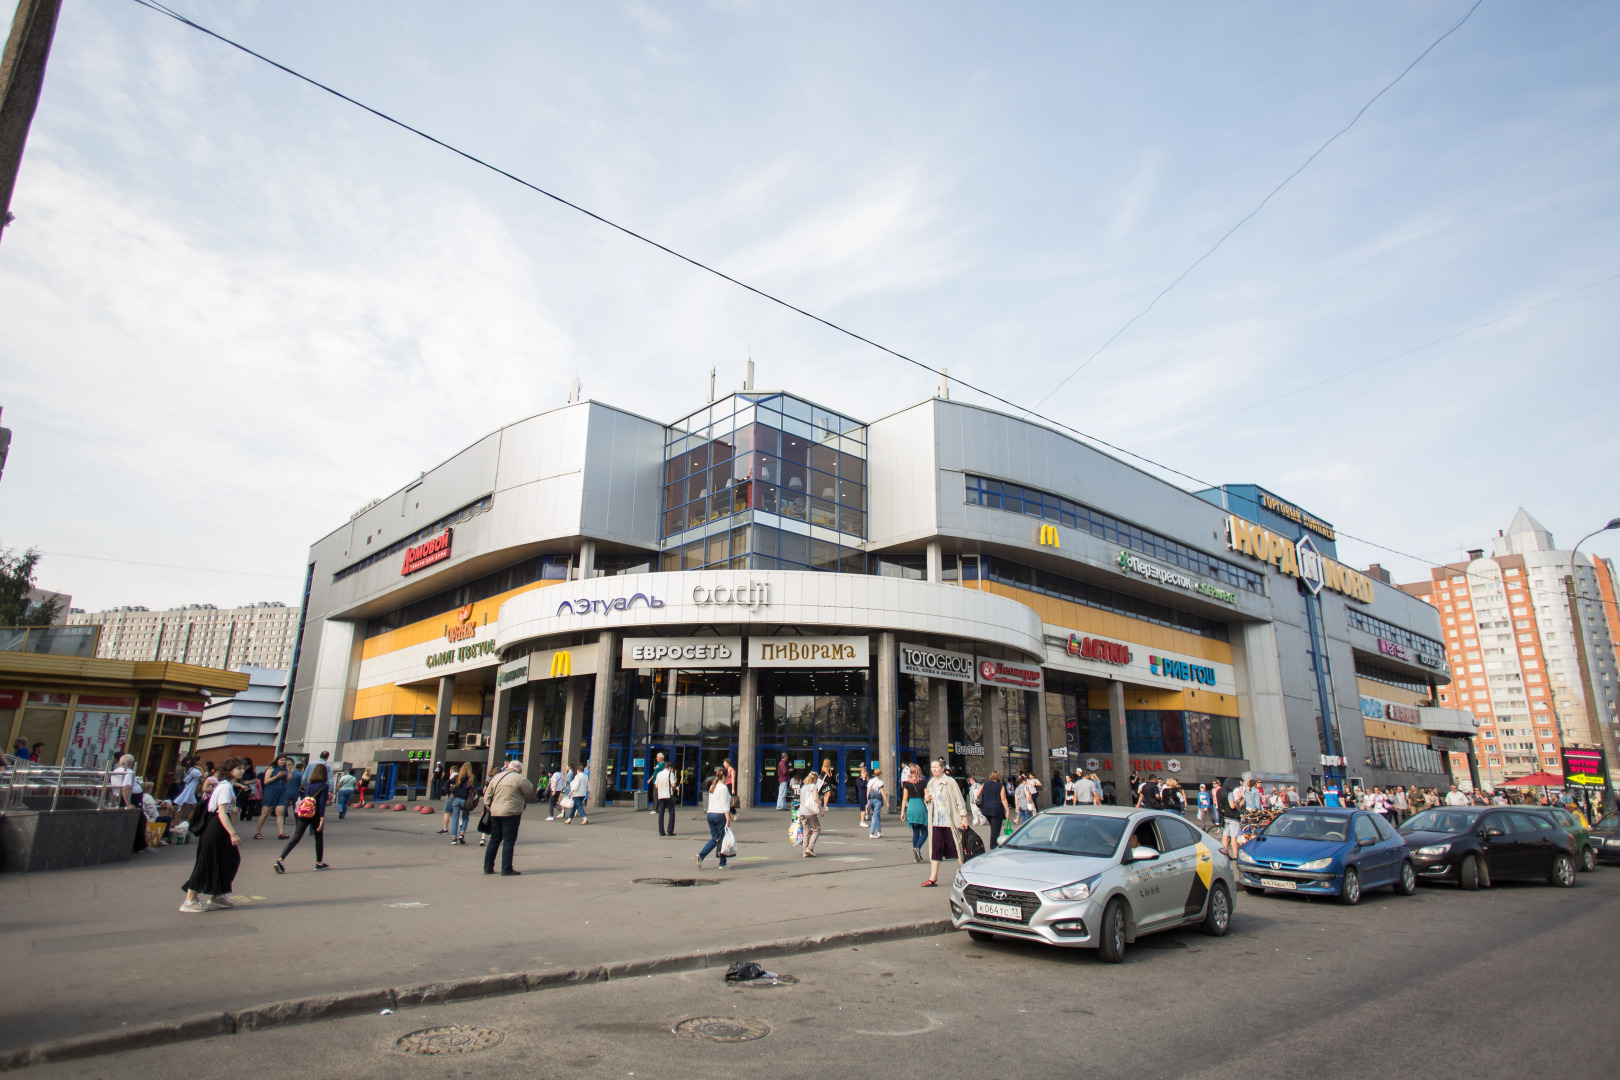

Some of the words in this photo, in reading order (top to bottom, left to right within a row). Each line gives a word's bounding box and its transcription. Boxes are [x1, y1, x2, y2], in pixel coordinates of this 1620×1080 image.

[1262, 492, 1302, 523] ТОРГОВЫЙ
[1230, 514, 1299, 579] НОРД
[1321, 556, 1375, 604] NORD
[692, 582, 770, 613] oodji
[426, 650, 455, 668] САЛОН
[632, 643, 732, 661] ЕВРОСЕТЬ
[904, 648, 973, 674] TOTOGROUP
[1080, 636, 1130, 666] ДЕТКИ
[1163, 657, 1190, 681] РИВ
[1191, 663, 1217, 686] ГОШ
[1568, 759, 1599, 767] ИНТИМ
[1570, 766, 1598, 774] БУТИК
